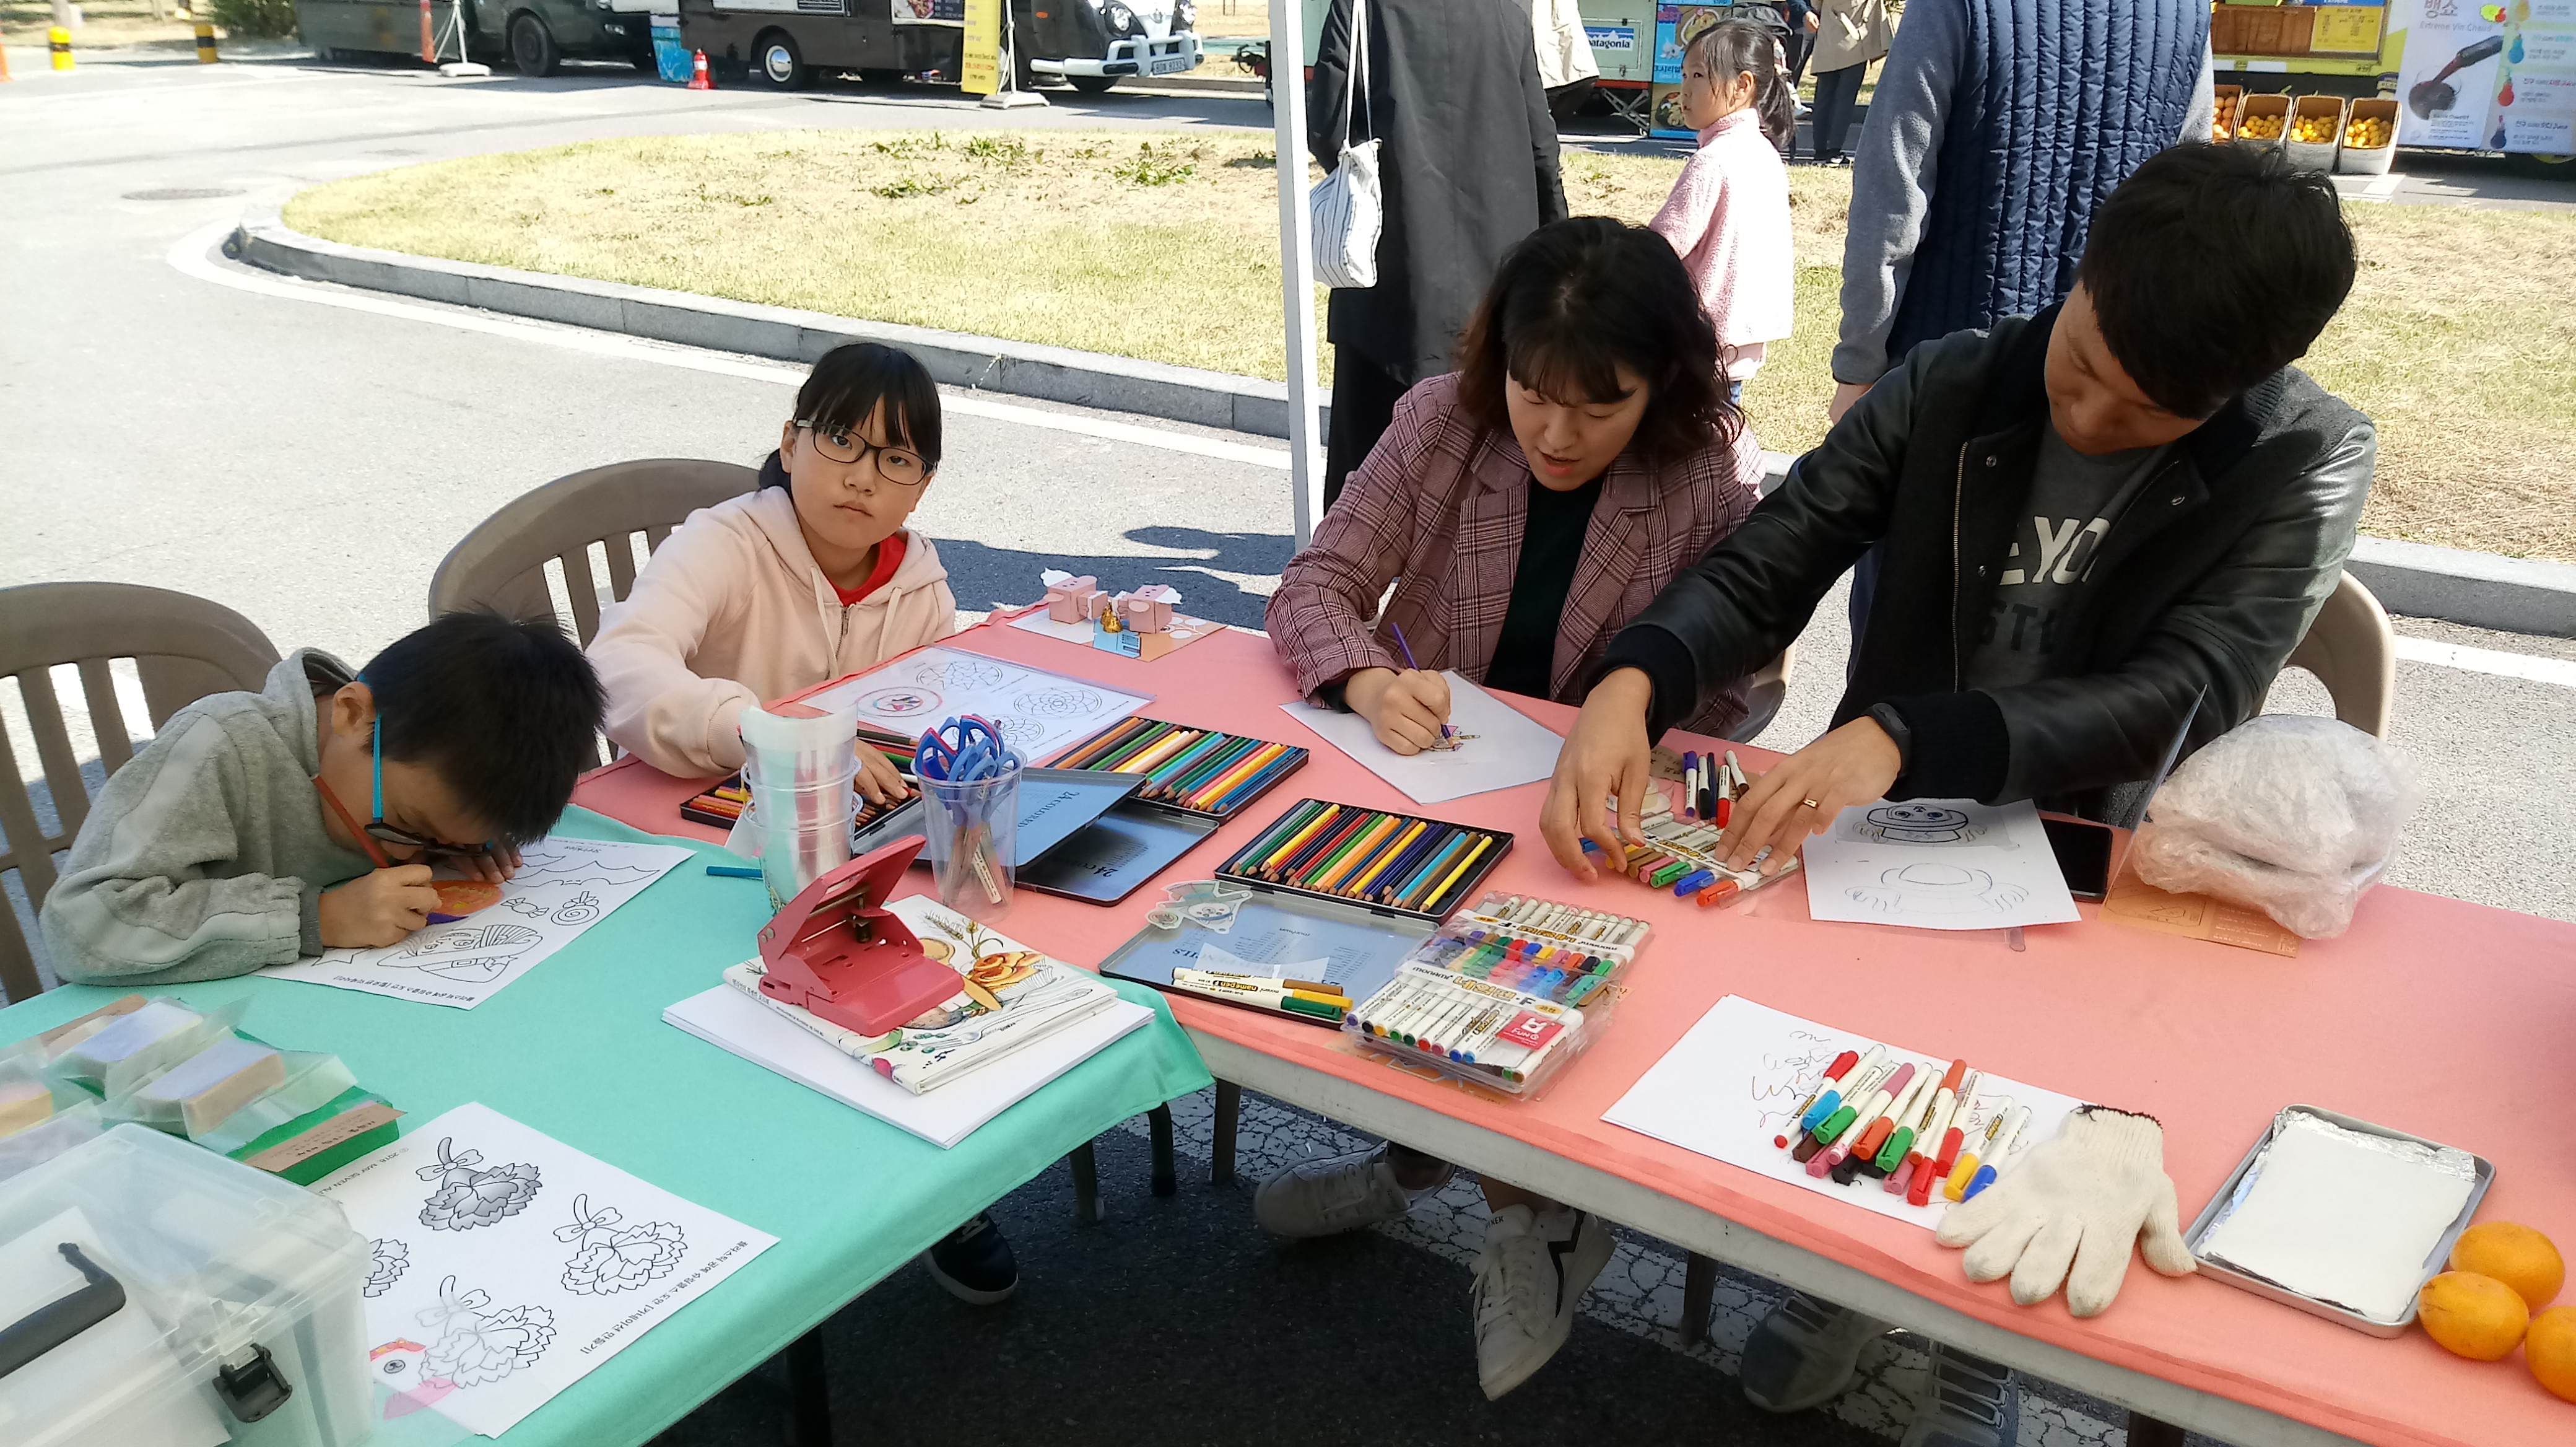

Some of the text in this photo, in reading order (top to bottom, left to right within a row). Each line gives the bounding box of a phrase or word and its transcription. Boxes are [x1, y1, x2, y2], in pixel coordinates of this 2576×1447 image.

[2419, 21, 2492, 32] Extreme Vin Chaud
[1093, 866, 1119, 878] 24
[1220, 979, 1257, 992] namepen
[333, 1172, 360, 1187] SEVEN
[715, 1241, 747, 1262] 플라스틱
[699, 1261, 718, 1273] 공예
[669, 1272, 700, 1292] 슈링클스
[651, 1292, 671, 1305] 도안
